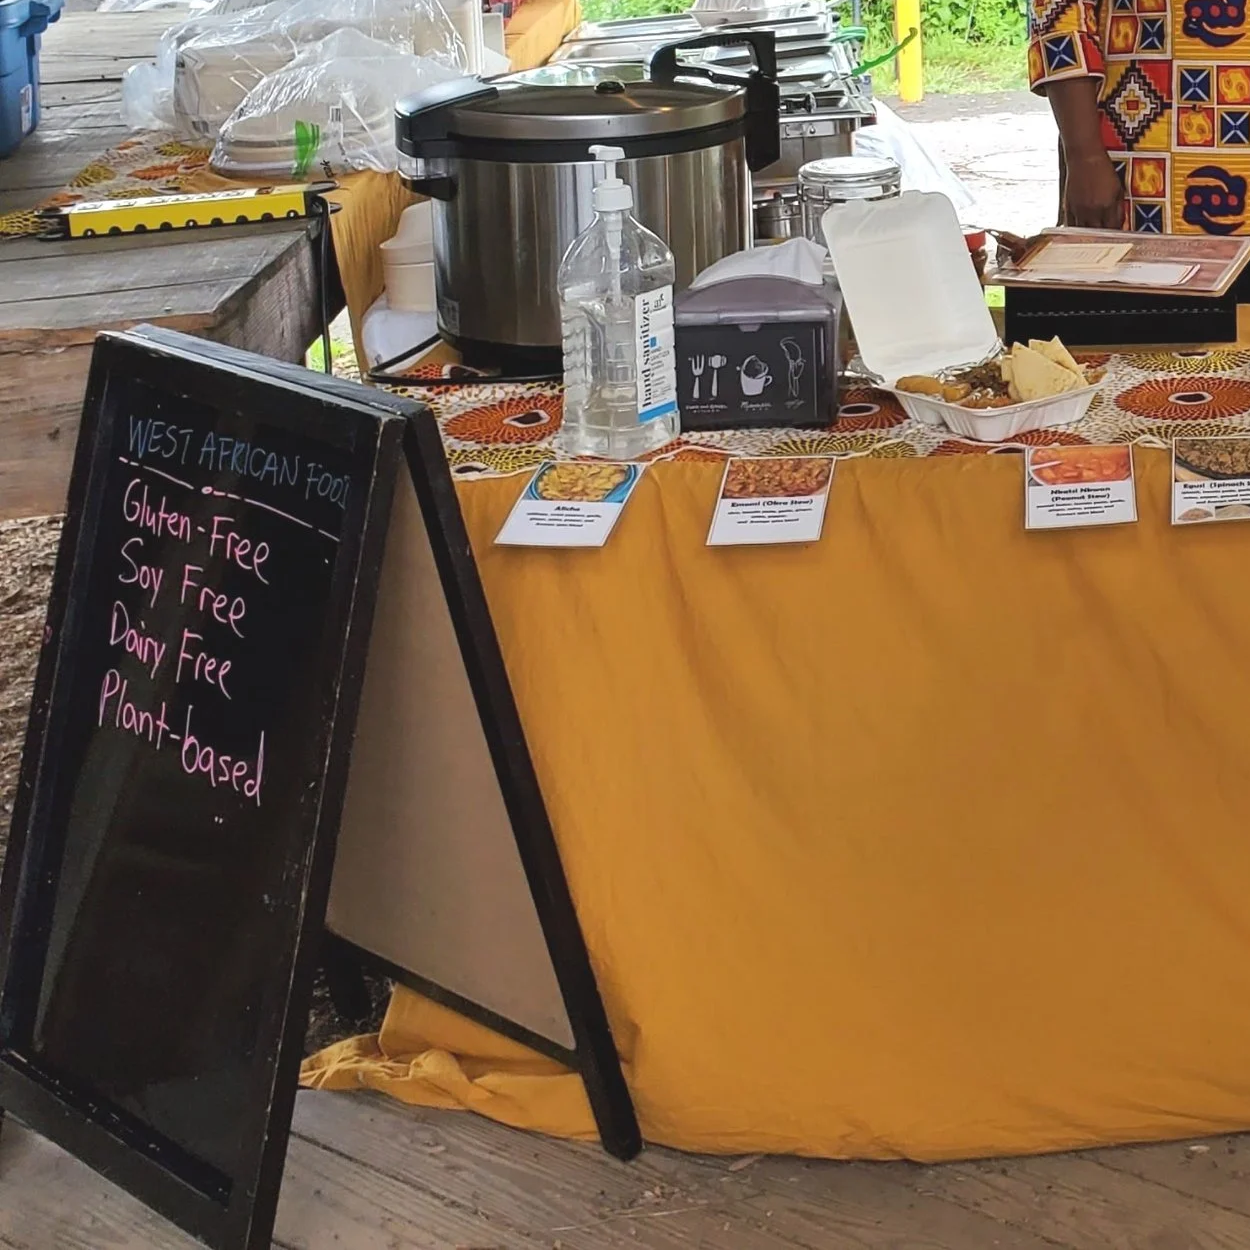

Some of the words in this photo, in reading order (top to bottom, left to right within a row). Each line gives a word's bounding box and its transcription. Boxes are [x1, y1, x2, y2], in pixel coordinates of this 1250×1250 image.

[640, 298, 650, 366] sanitizer
[641, 368, 652, 408] hand
[129, 414, 194, 465] WEST
[199, 431, 300, 487] AFRICAN
[118, 537, 164, 609] Soy
[181, 564, 245, 638] Free
[110, 600, 166, 680] Dairy
[176, 627, 231, 700] Free
